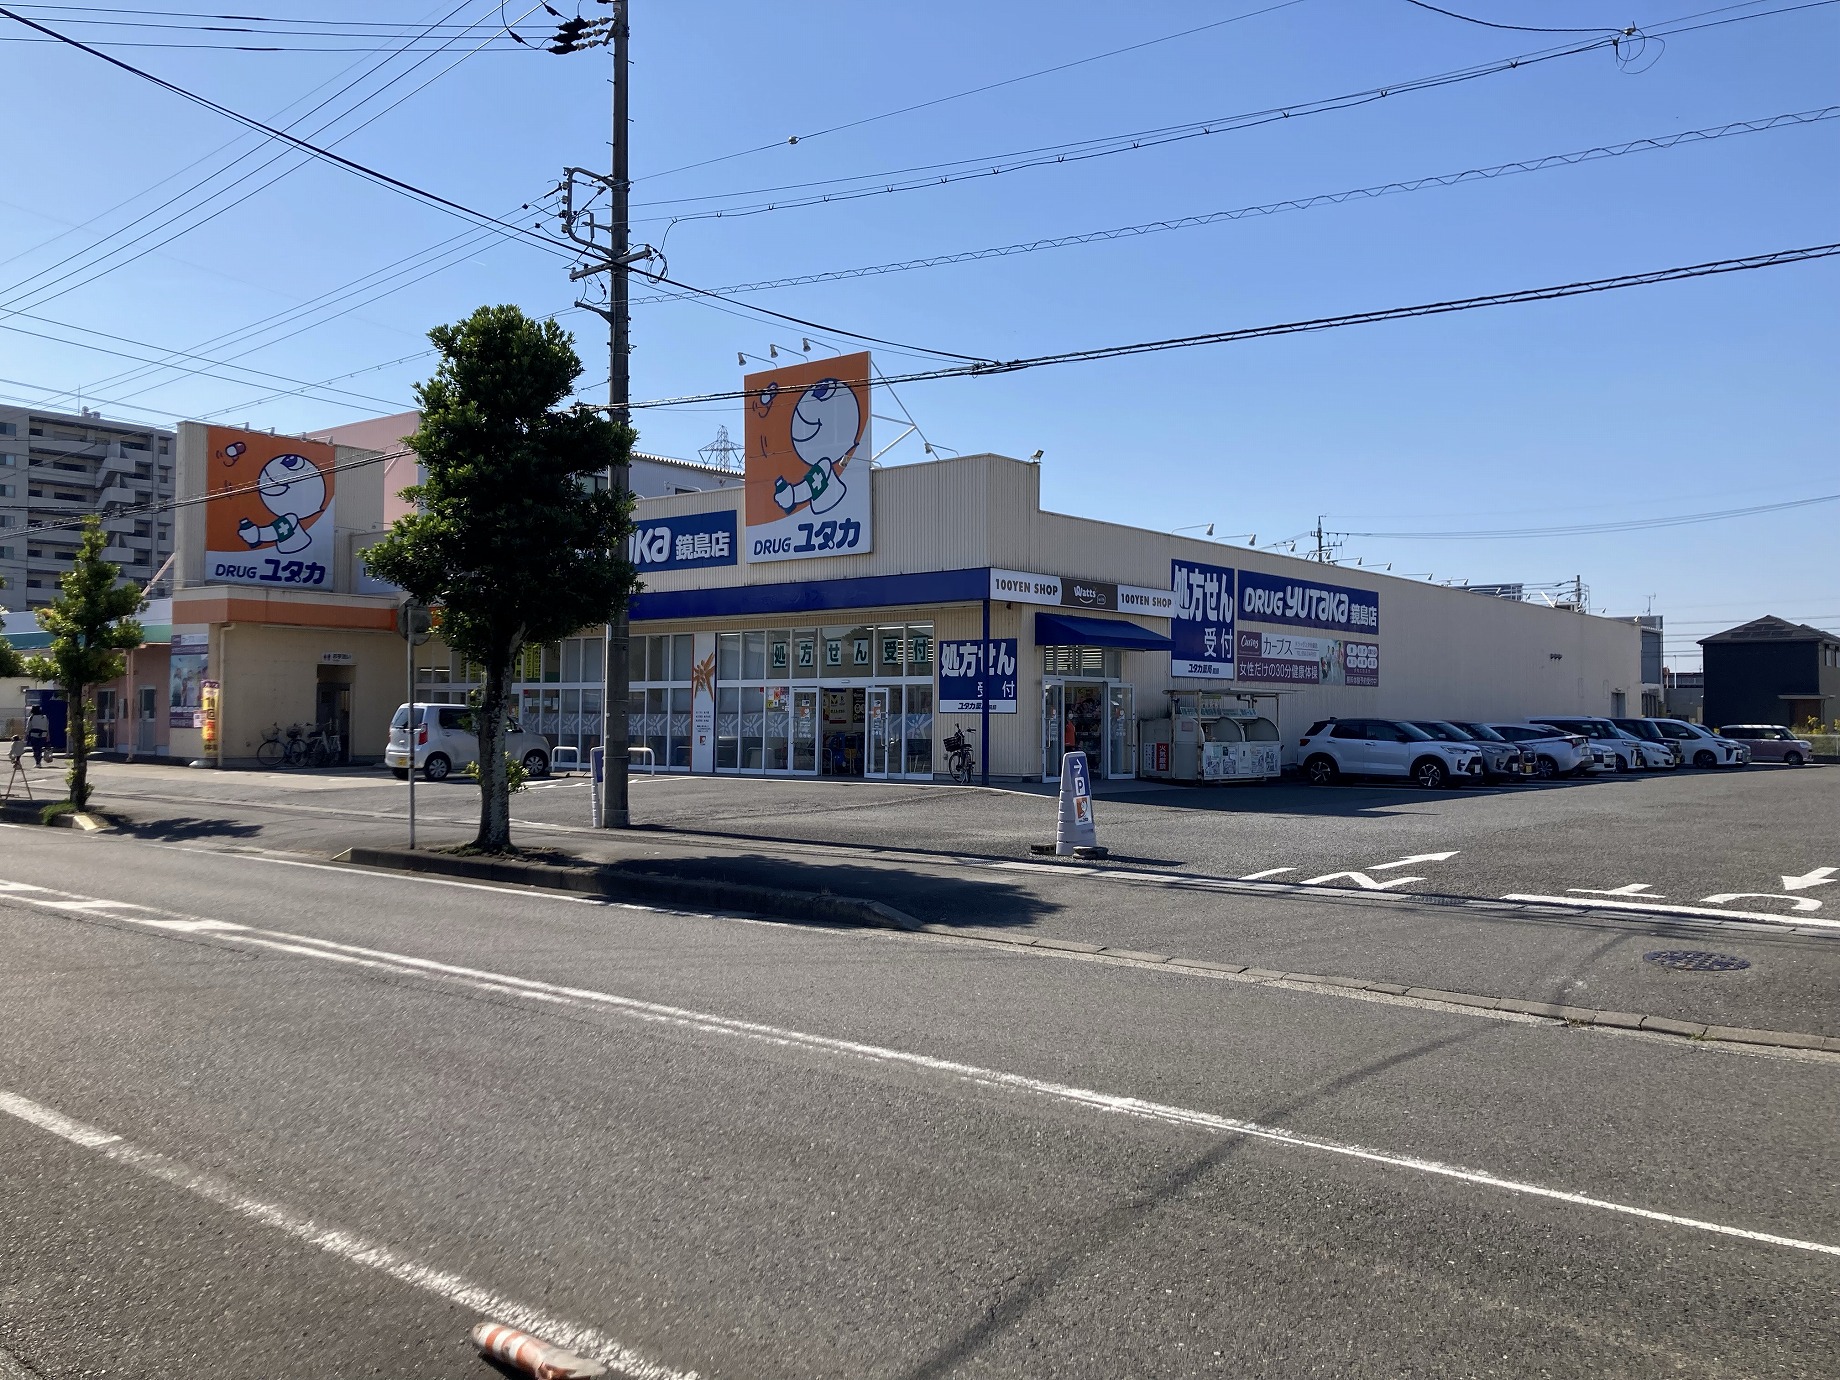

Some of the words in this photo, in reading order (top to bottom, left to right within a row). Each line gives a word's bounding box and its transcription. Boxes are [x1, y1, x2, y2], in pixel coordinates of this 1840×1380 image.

[675, 530, 731, 561] 鏡島店
[754, 537, 792, 556] DRUG
[794, 517, 861, 553] ユタカ
[214, 563, 258, 579] DRUG
[259, 558, 326, 585] ユタカ
[995, 578, 1031, 594] 100YEN
[1033, 581, 1059, 596] SHOP
[1073, 585, 1096, 599] Watts
[1121, 593, 1150, 606] 100YEN
[1152, 597, 1172, 608] SHOP
[1174, 564, 1234, 624] 処方せん
[1244, 587, 1284, 616] DRUG
[1349, 603, 1378, 627] 鏡島店
[1203, 627, 1234, 660] 受付
